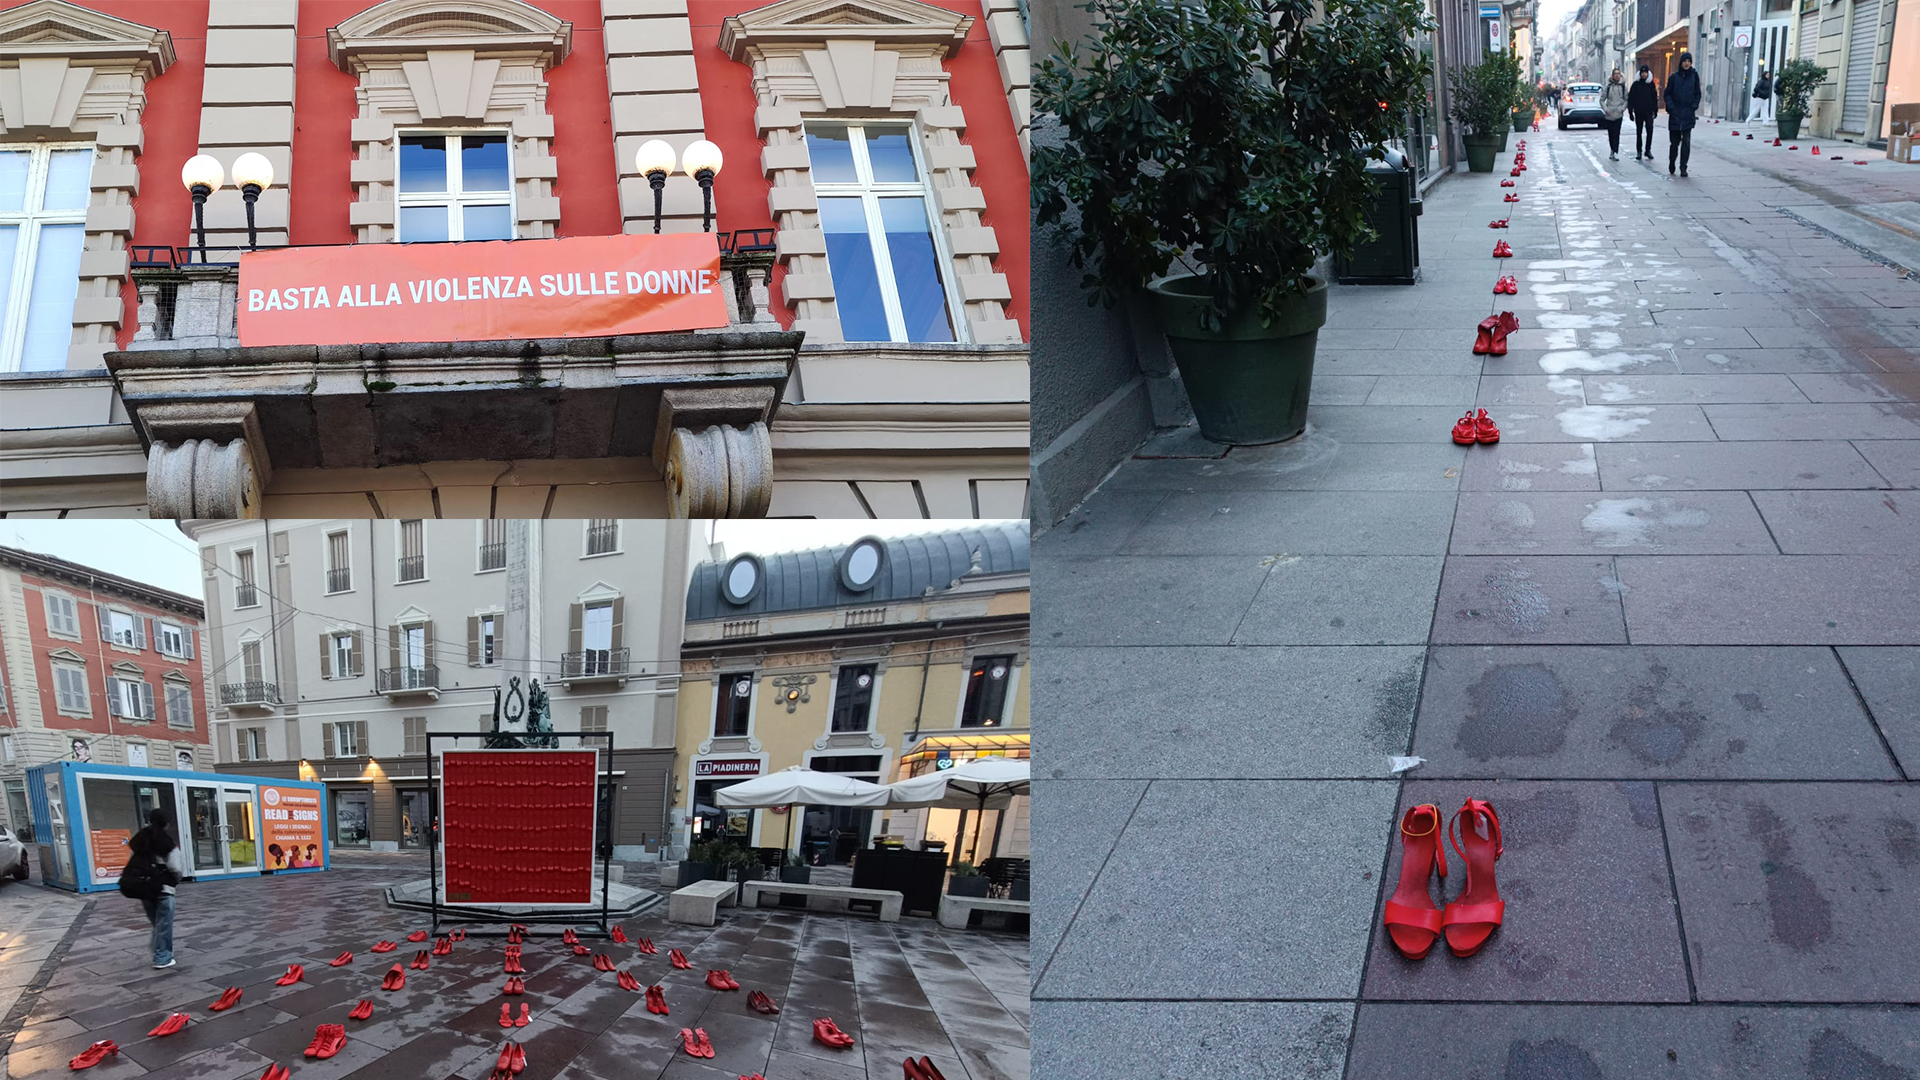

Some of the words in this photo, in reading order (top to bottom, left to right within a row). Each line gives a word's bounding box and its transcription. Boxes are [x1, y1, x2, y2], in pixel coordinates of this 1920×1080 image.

[248, 286, 331, 312] BASTA
[336, 282, 402, 307] ALLA
[408, 276, 534, 304] VIOLENZA
[540, 271, 620, 296] SULLE
[626, 269, 712, 295] DONNE
[699, 764, 710, 772] LA
[712, 763, 759, 772] PIADINERIA
[264, 809, 288, 820] READ
[293, 810, 318, 820] SIGNS
